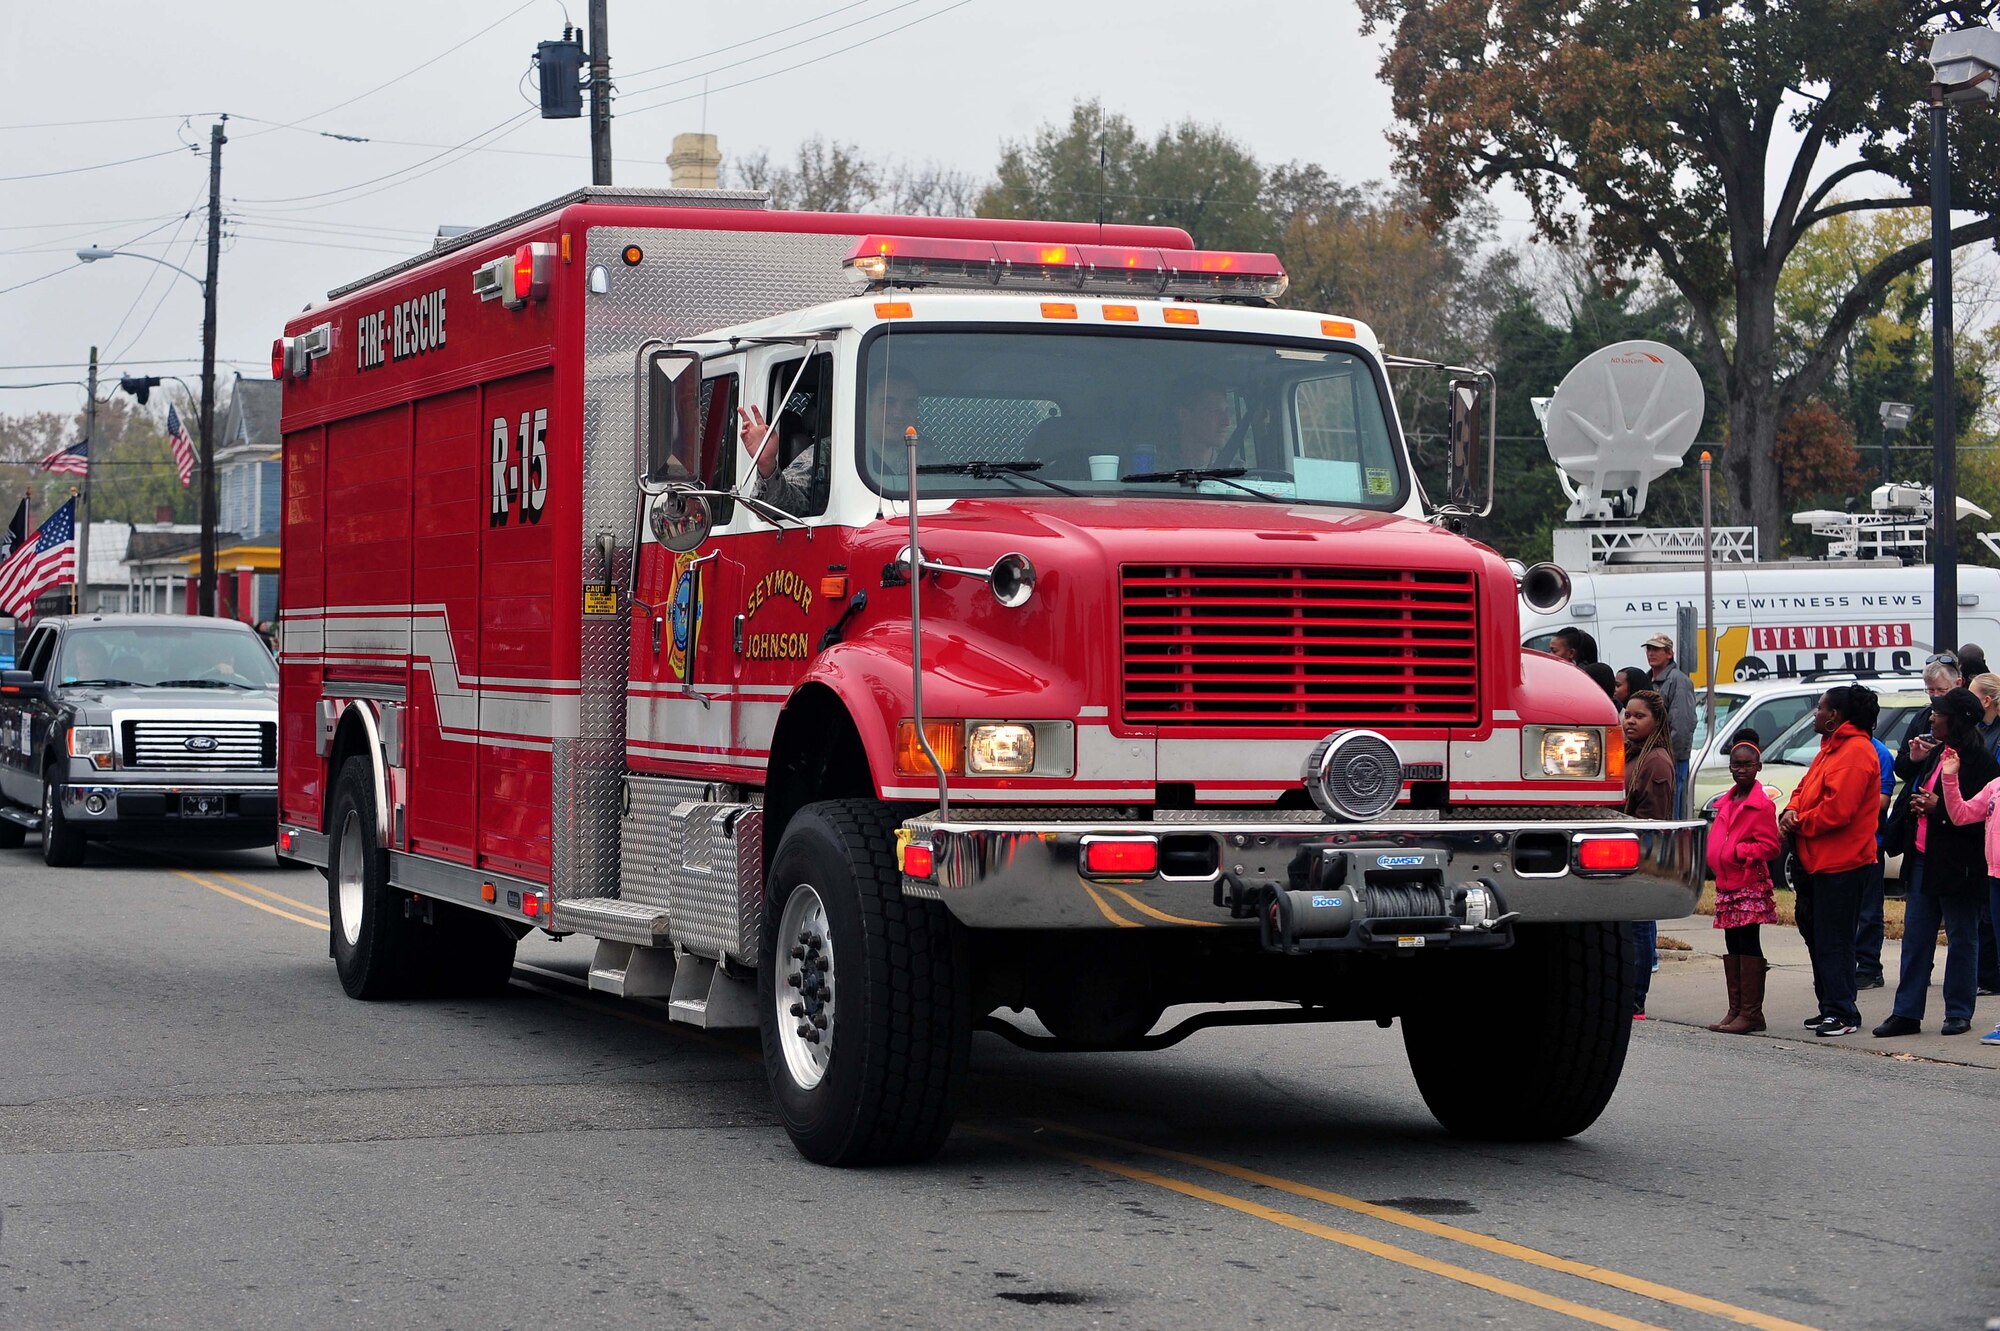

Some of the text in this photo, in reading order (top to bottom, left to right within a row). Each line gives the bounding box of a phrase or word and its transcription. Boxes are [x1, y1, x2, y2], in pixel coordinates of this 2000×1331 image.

[358, 288, 446, 369] FIRE RESCUE
[492, 408, 548, 515] R-15
[748, 569, 813, 618] SEYMOUR
[1625, 601, 1668, 612] ABC
[1862, 595, 1922, 606] NEWS
[745, 633, 809, 658] JOHNSON
[1759, 624, 1904, 650] EYEWITNESS
[192, 739, 211, 748] Ford
[1383, 856, 1424, 865] RAMSEY
